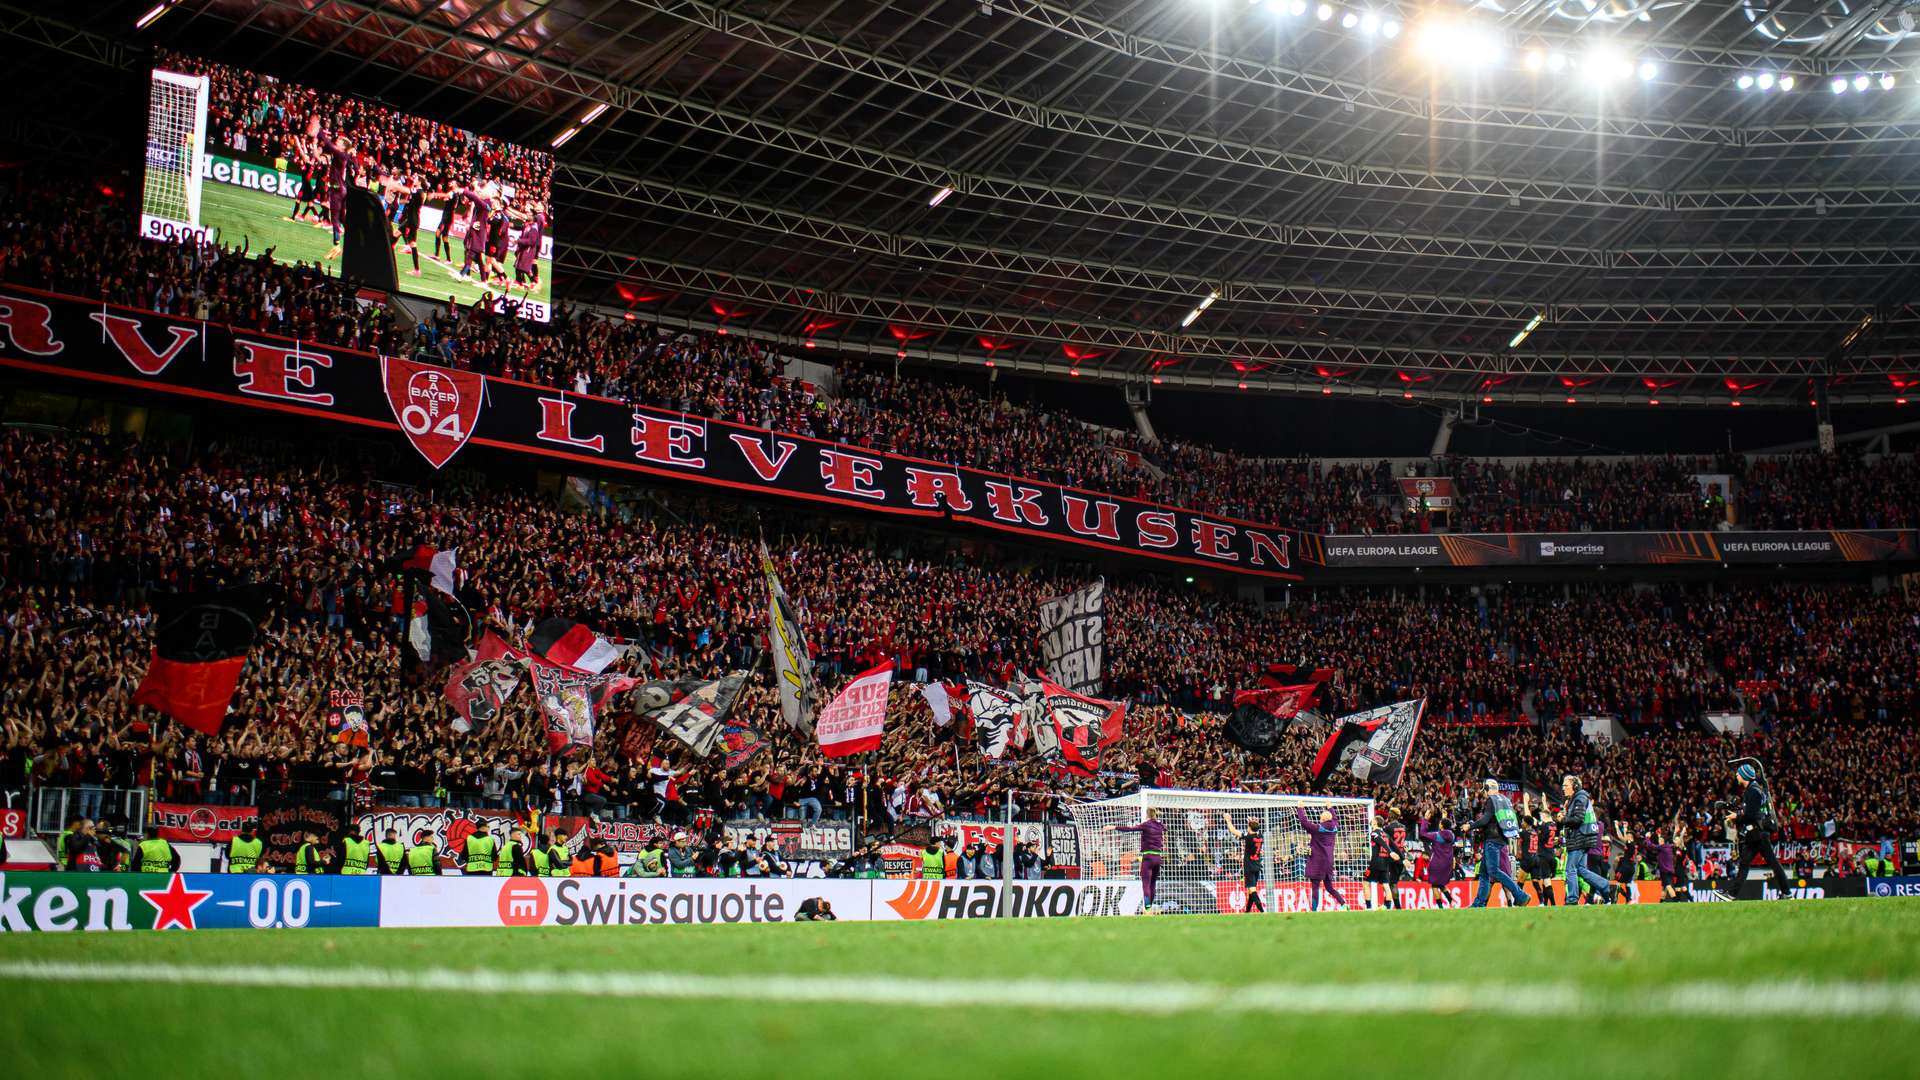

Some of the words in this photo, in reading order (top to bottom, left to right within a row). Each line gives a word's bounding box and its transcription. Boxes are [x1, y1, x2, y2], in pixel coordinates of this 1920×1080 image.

[411, 387, 456, 403] BAYER
[402, 405, 465, 442] 04
[536, 397, 1292, 569] LEVERKUSEN
[1328, 547, 1355, 556] UEFA
[1357, 546, 1397, 556] EUROPA
[1398, 546, 1439, 555] LEAGUE
[1723, 543, 1750, 552] UEFA
[1752, 542, 1790, 552] EUROPA
[1792, 542, 1831, 551] LEAGUE
[153, 811, 189, 829] LEV
[1051, 826, 1075, 839] WEST
[1052, 840, 1076, 852] SIDE
[884, 861, 912, 870] RESPECT
[1054, 853, 1077, 866] BOYZ
[249, 878, 311, 929] 0.0
[556, 879, 785, 926] Swissquote
